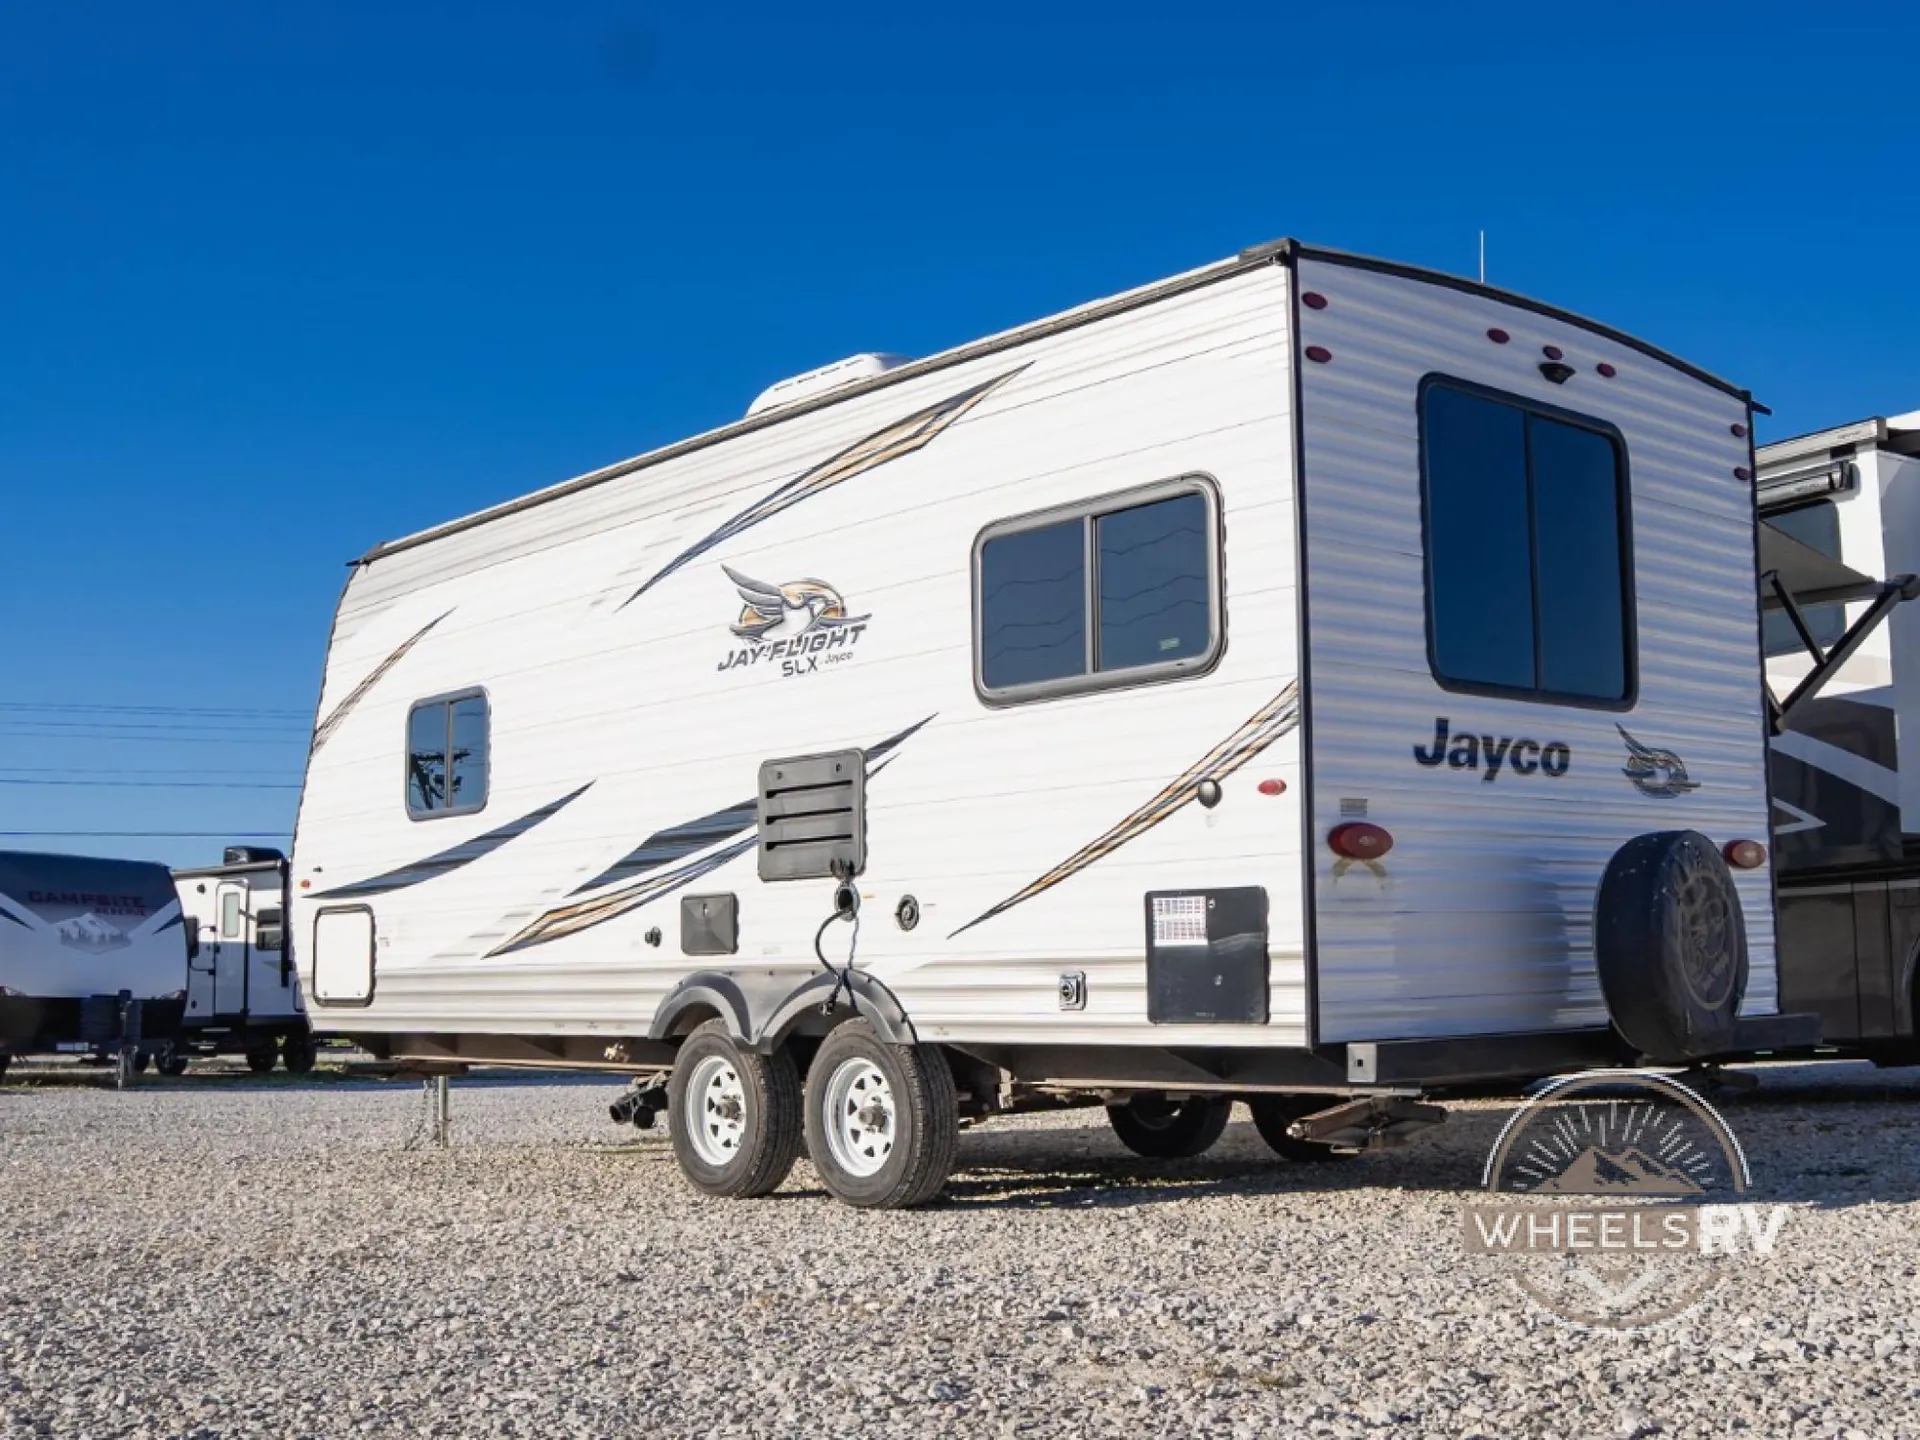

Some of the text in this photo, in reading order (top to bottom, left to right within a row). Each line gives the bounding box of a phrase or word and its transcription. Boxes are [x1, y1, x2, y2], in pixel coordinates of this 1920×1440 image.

[782, 655, 819, 677] SLX
[1413, 717, 1571, 783] Jayco
[26, 890, 147, 908] CAMPSITE
